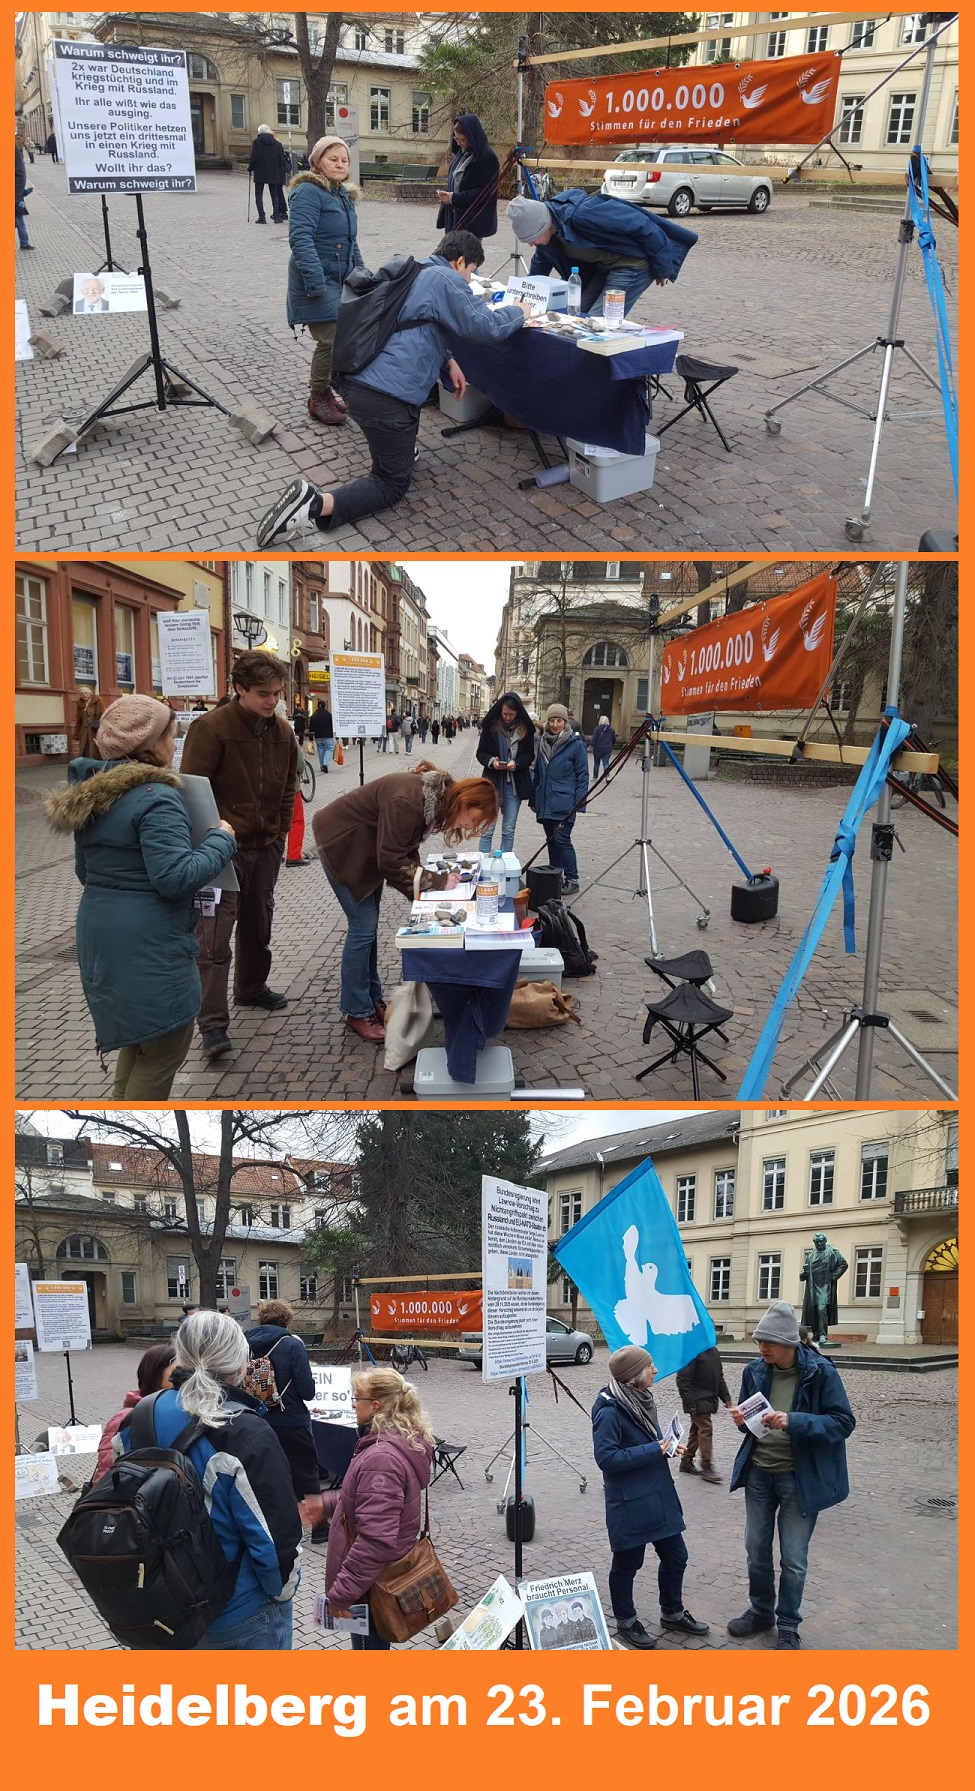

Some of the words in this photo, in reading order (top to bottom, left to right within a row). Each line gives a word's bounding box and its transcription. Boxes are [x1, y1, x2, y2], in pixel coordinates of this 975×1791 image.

[60, 45, 104, 58] Warum
[108, 50, 158, 64] schweigt
[161, 54, 181, 64] ihr?
[72, 62, 84, 71] 2x
[111, 65, 174, 77] Deutschland
[72, 72, 142, 86] kriegstüchtig
[146, 78, 163, 86] und
[76, 82, 104, 93] Krieg
[108, 84, 124, 92] mit
[128, 85, 176, 95] Russland.
[94, 98, 112, 106] alle
[115, 99, 137, 107] wißt
[140, 100, 156, 108] wie
[160, 101, 176, 109] das
[605, 82, 725, 114] 1.000.000
[108, 109, 152, 119] ausging.
[68, 121, 106, 130] Unsere
[110, 122, 152, 131] Politiker
[156, 124, 186, 132] hetzen
[590, 119, 634, 131] Stimmen
[639, 118, 657, 129] für
[660, 118, 682, 129] den
[688, 117, 741, 128] Frieden
[94, 132, 117, 141] jetzt
[86, 141, 95, 149] in
[131, 142, 157, 152] Krieg
[109, 150, 159, 158] Russland.
[96, 163, 125, 172] Wollt
[129, 164, 143, 172] ihr
[147, 164, 172, 172] das?
[74, 180, 115, 190] Warum
[120, 179, 168, 190] schweigt
[172, 179, 192, 188] ihr?
[522, 281, 535, 290] Bitte
[690, 630, 754, 676] 1.000.000
[681, 686, 703, 697] Stimmen
[706, 684, 714, 693] für
[716, 681, 728, 693] den
[731, 675, 762, 690] Frieden
[401, 1301, 452, 1314] 1.000.000
[530, 1581, 563, 1592] Friedrich
[526, 1590, 555, 1601] braucht
